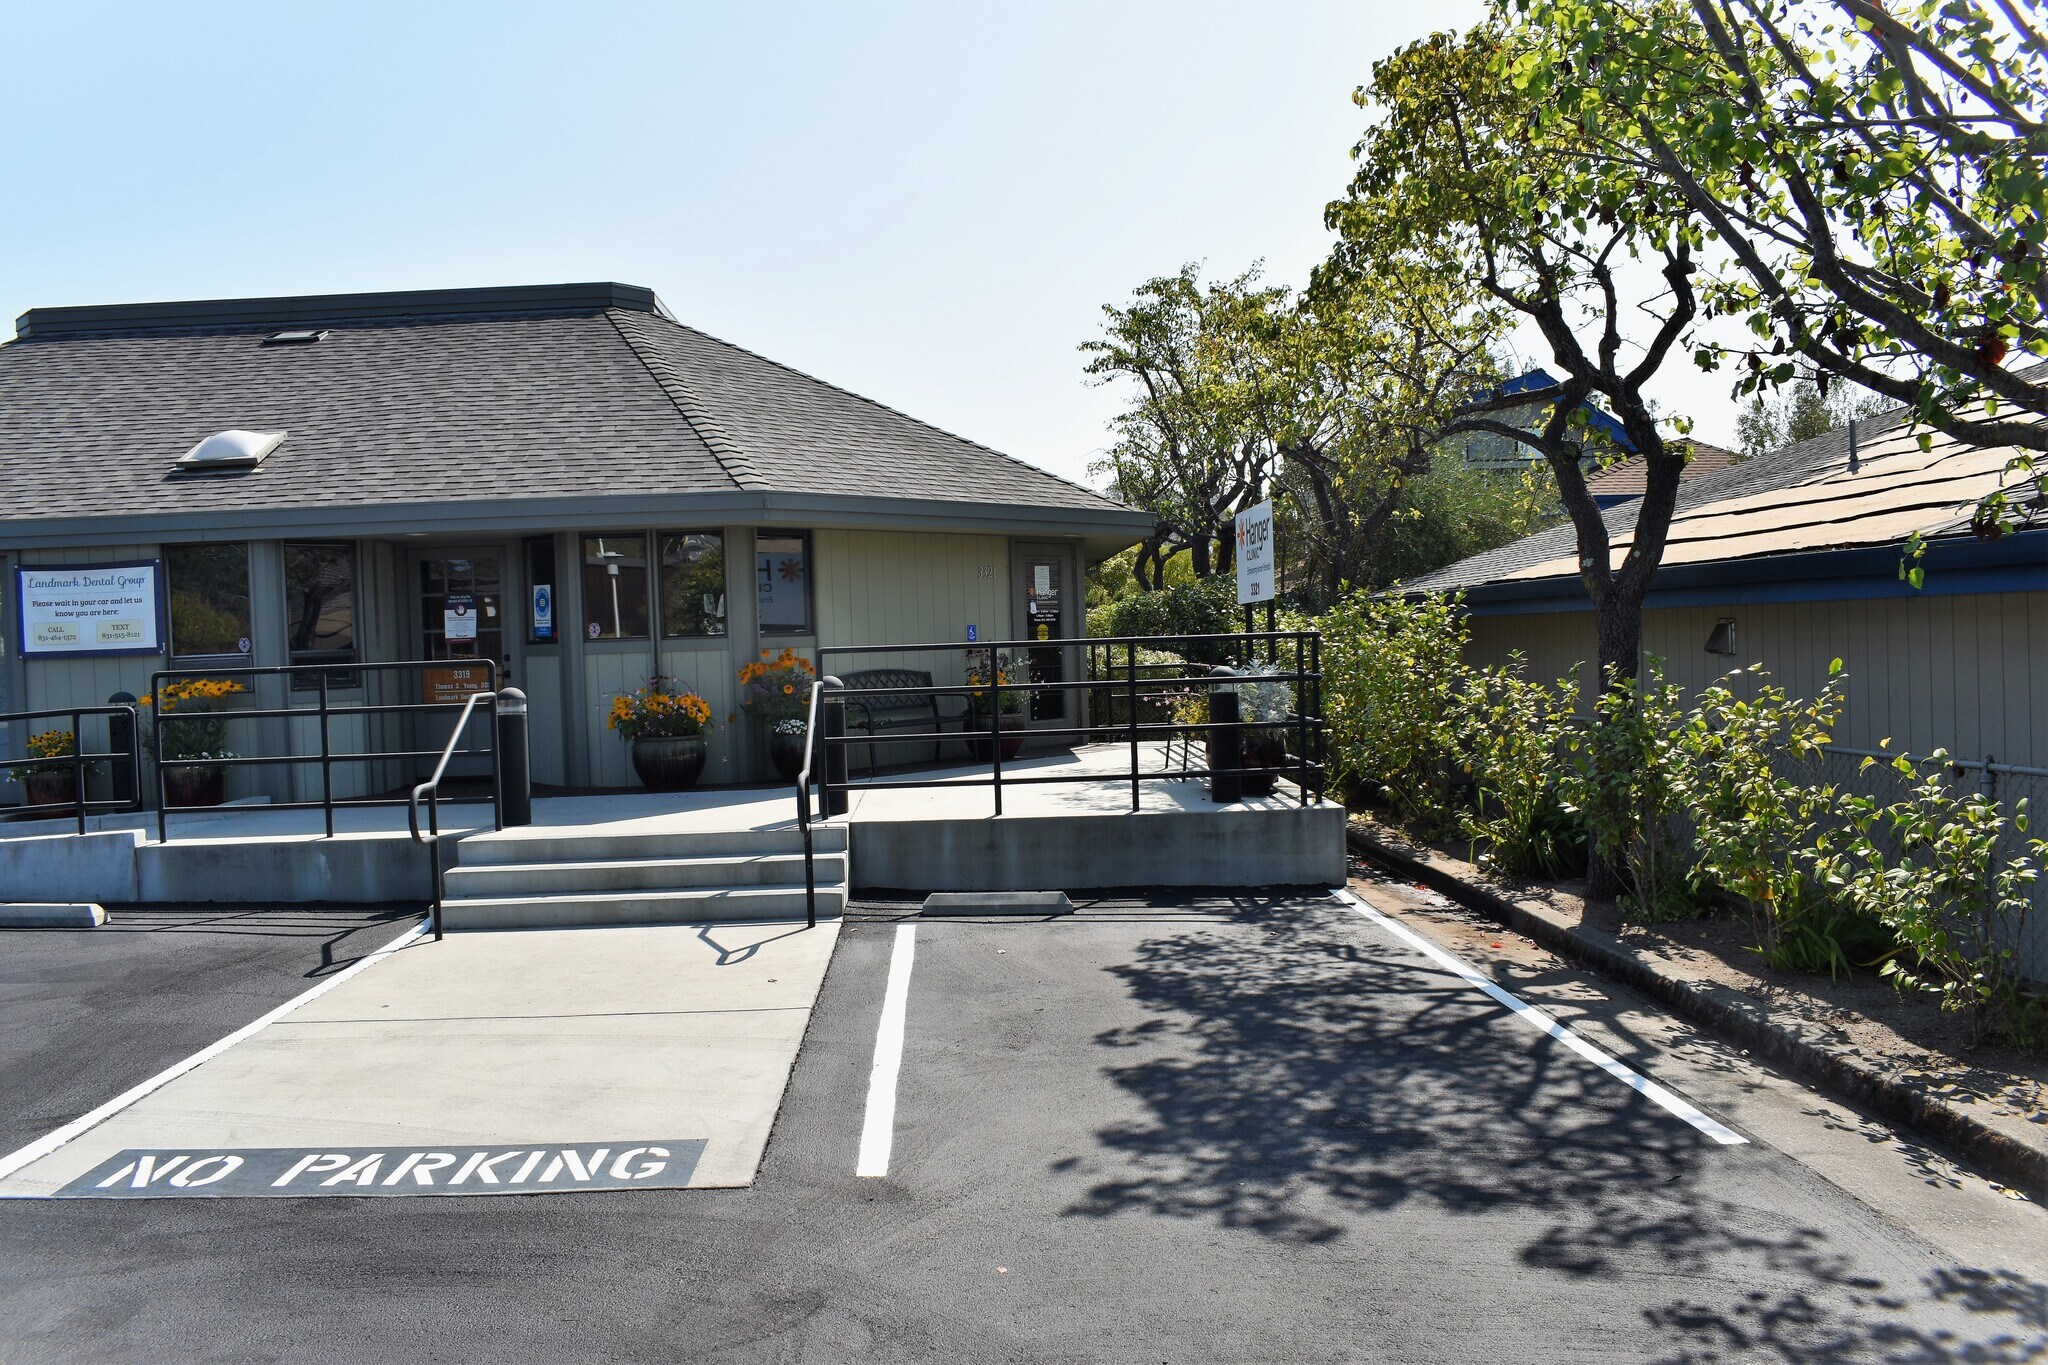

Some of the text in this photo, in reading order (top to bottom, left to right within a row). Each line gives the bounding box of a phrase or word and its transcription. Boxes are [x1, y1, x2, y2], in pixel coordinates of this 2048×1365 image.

[1245, 517, 1270, 551] Hanger
[978, 566, 997, 579] 3321
[28, 575, 146, 589] Landmark Dental Group
[32, 600, 54, 608] Please
[54, 599, 71, 607] wait
[80, 600, 96, 608] your
[110, 597, 123, 605] and
[54, 610, 75, 618] know
[75, 611, 89, 619] you
[111, 623, 130, 631] TEXT
[453, 669, 471, 679] 3319
[435, 682, 454, 690] Thomas
[435, 693, 459, 701] Landmark
[94, 1146, 671, 1188] NO PARKING
